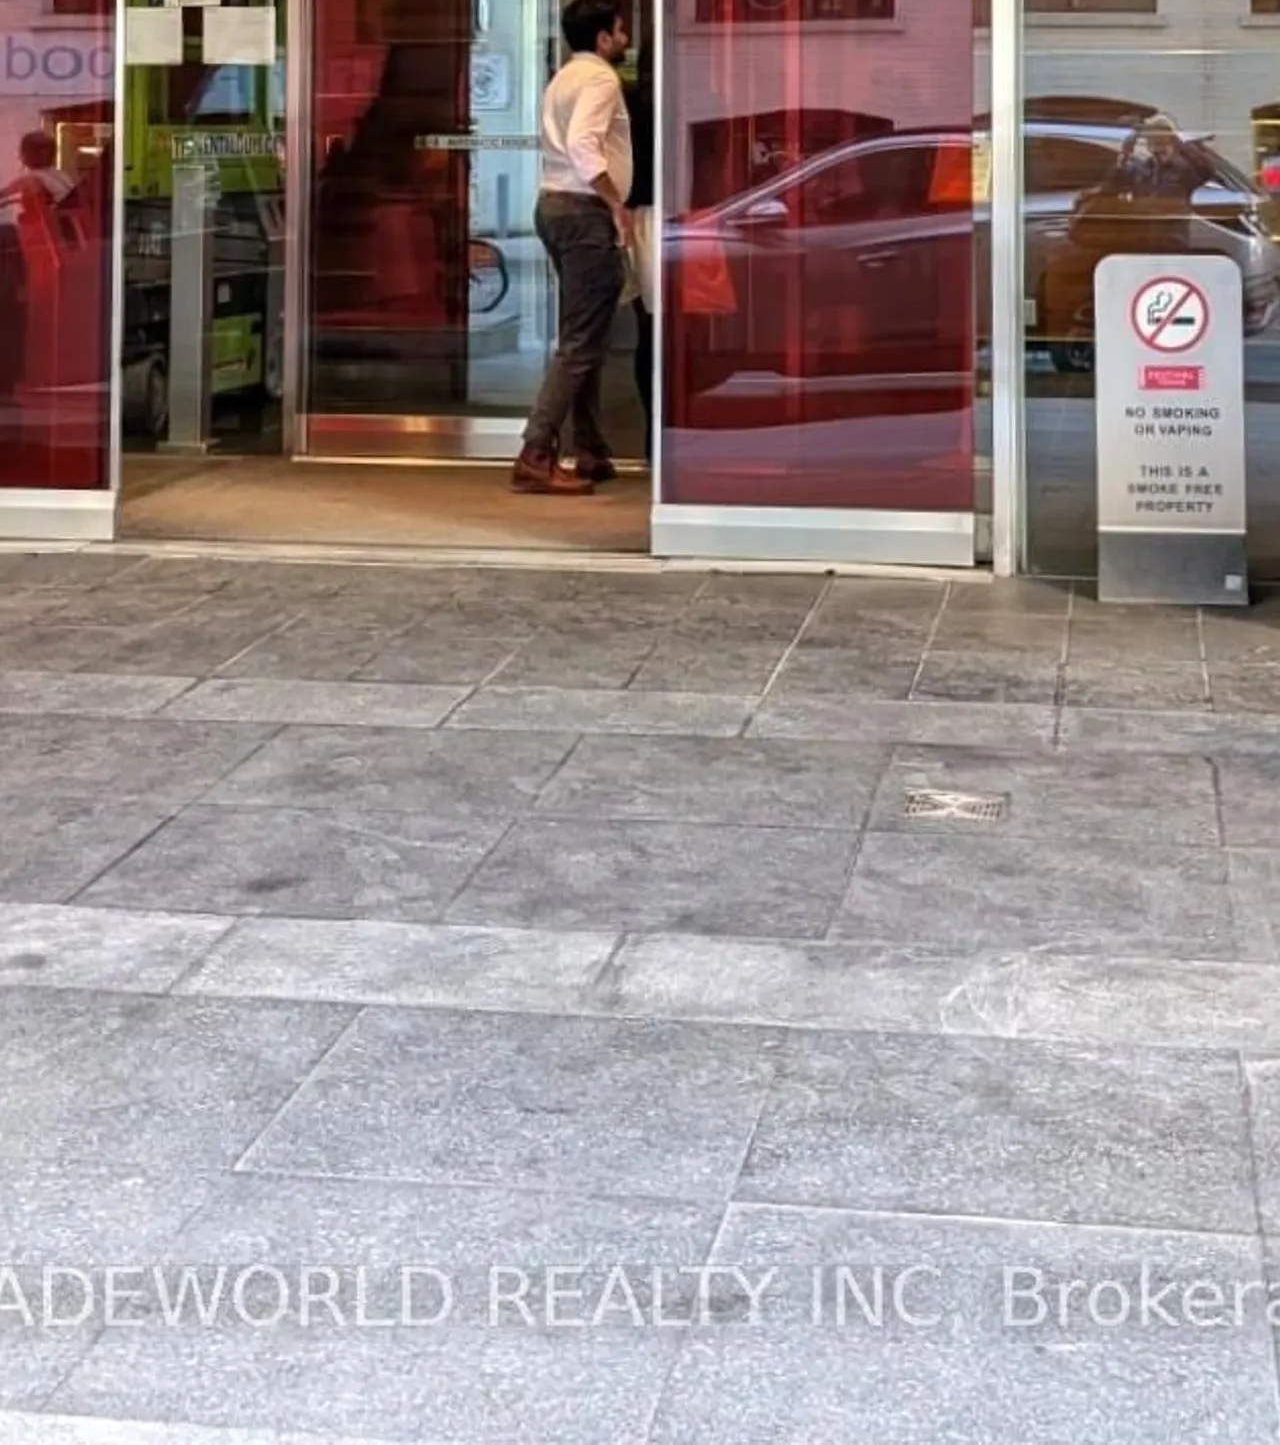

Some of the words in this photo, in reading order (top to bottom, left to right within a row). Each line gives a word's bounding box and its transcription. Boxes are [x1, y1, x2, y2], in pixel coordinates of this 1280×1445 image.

[1125, 407, 1146, 419] NO
[1152, 407, 1220, 419] SMOKING
[1134, 424, 1154, 435] OR
[1159, 424, 1213, 436] VAPING
[1141, 465, 1171, 477] THIS
[1178, 465, 1192, 477] IS
[1197, 466, 1210, 477] A
[1128, 483, 1178, 495] SMOKE
[1185, 483, 1224, 495] FREE
[1135, 500, 1214, 512] PROPERTY
